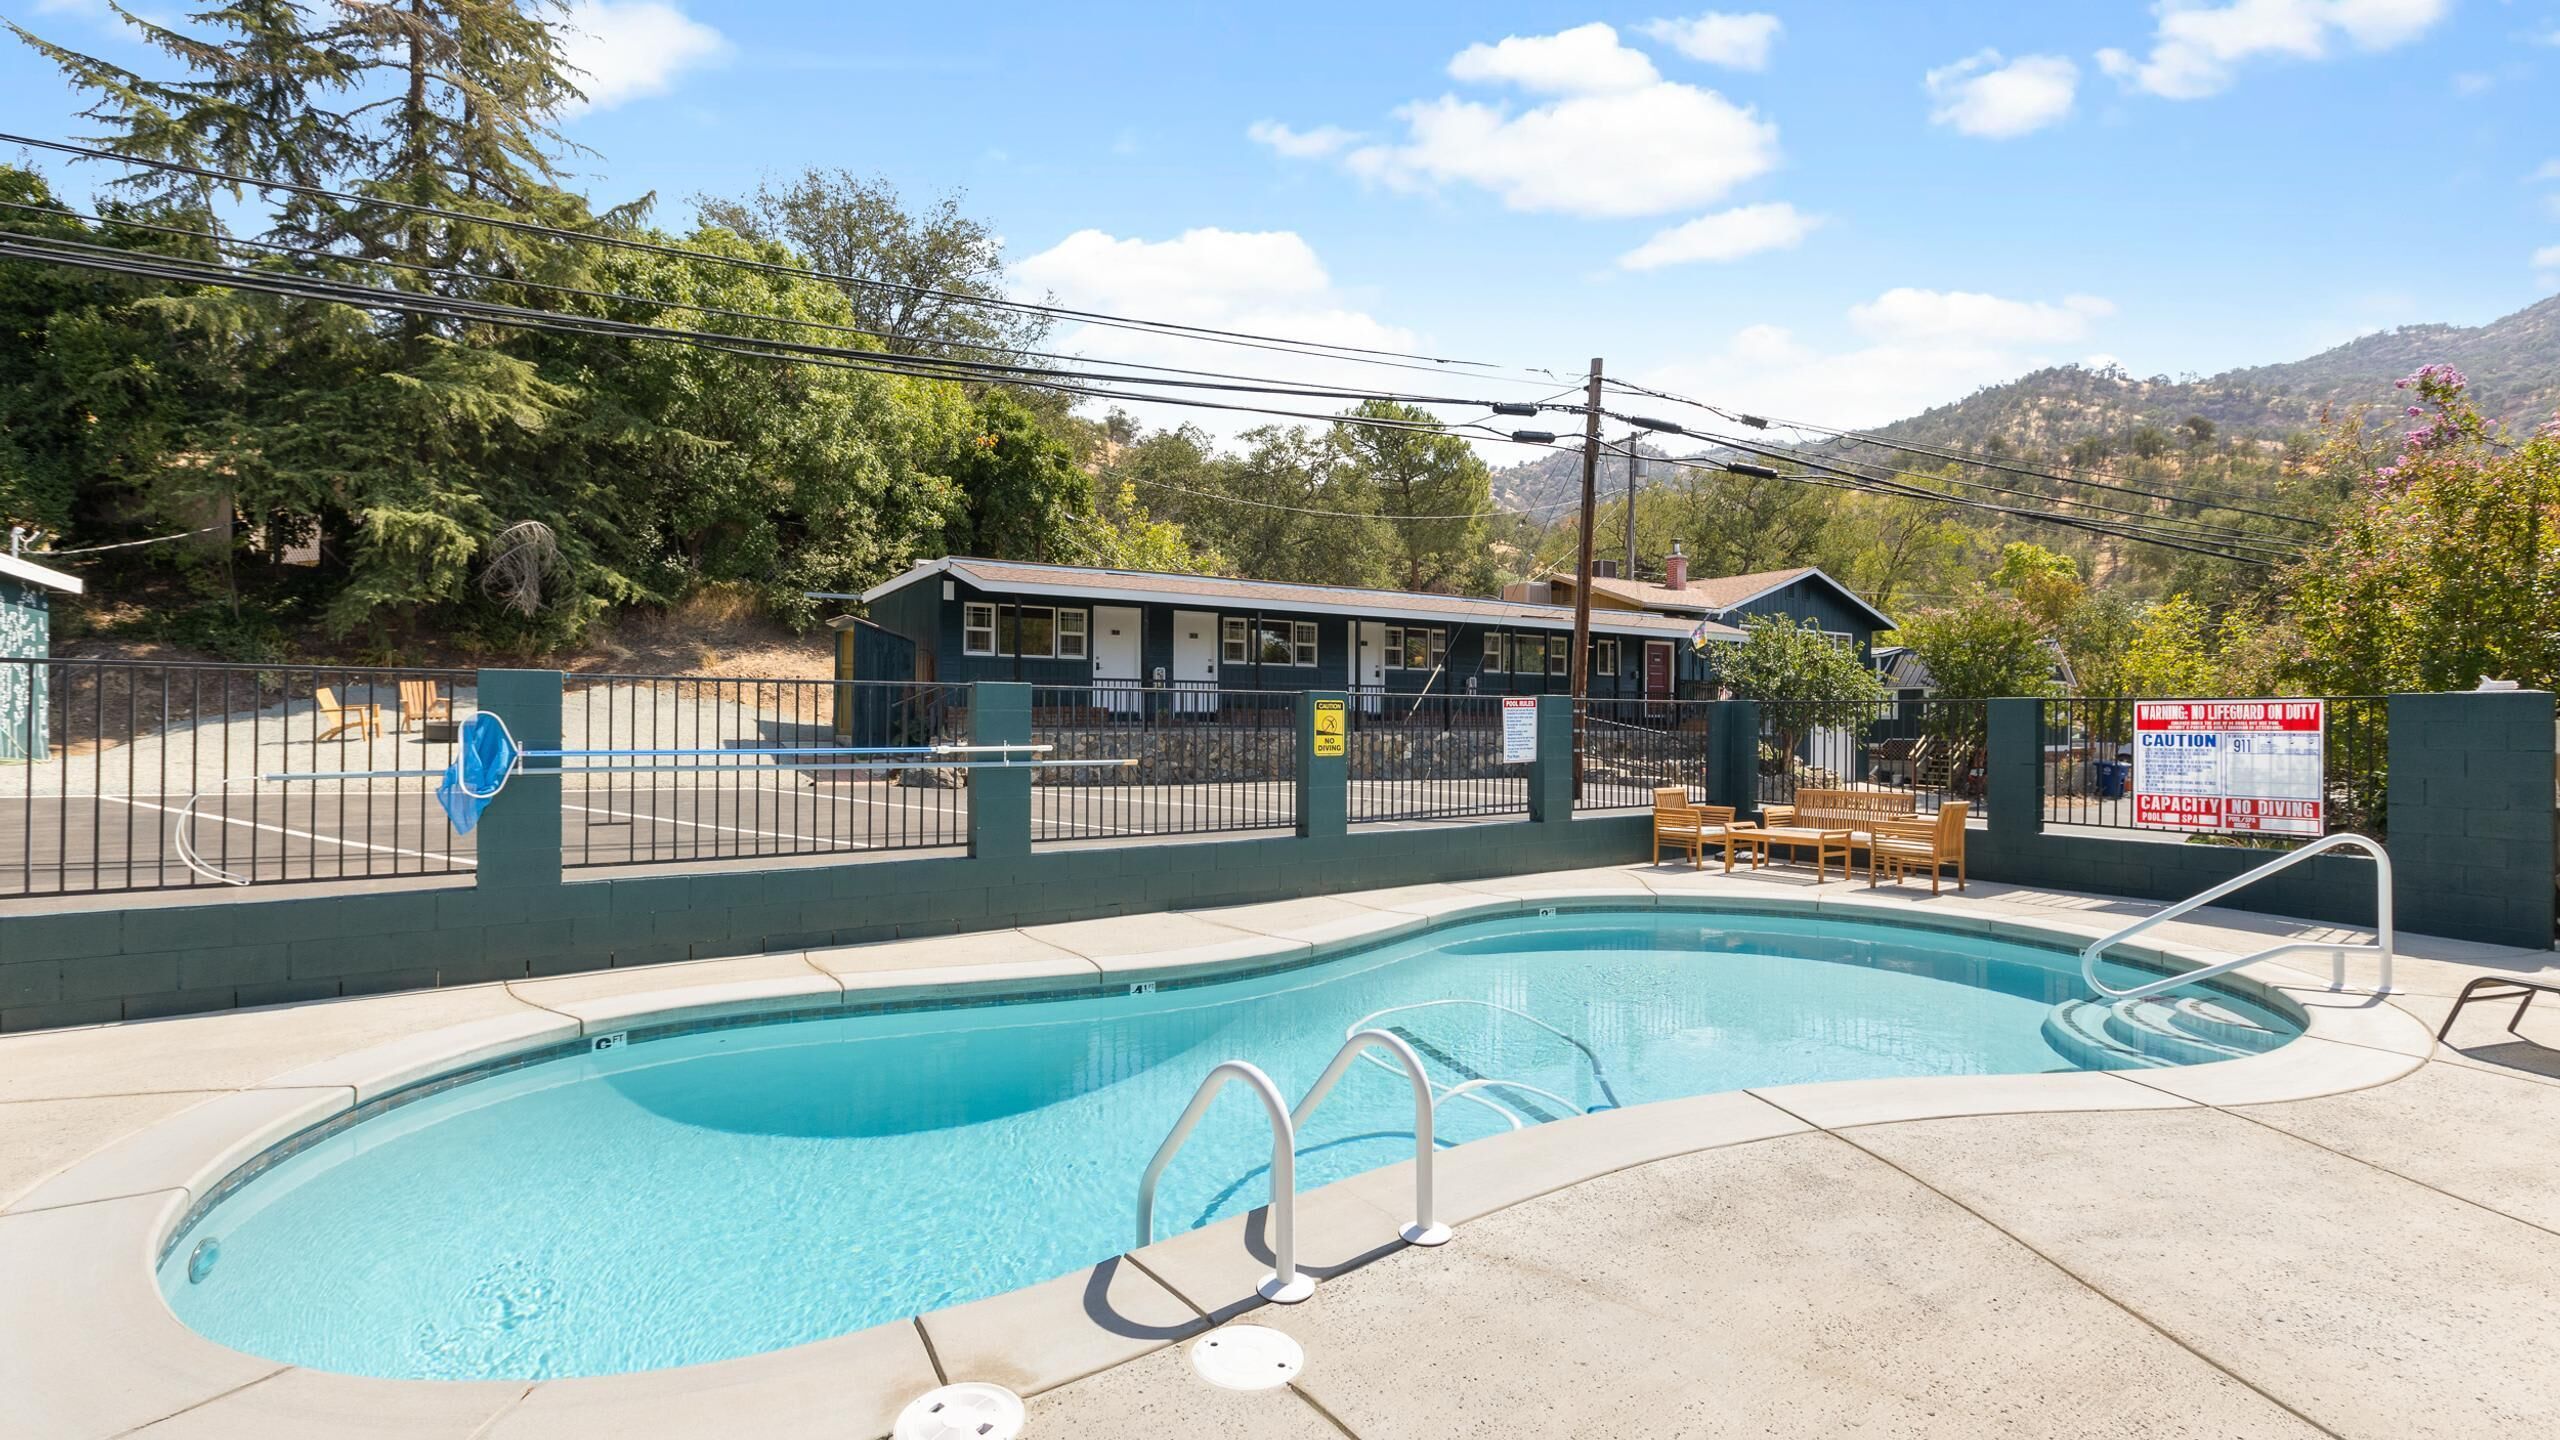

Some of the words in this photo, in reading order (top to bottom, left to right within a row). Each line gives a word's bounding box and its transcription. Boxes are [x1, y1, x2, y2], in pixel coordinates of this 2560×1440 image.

[2140, 705, 2188, 720] WARNING:
[2191, 704, 2205, 720] NO
[2207, 704, 2265, 720] LIFEGUARD
[2268, 703, 2283, 720] ON
[2285, 703, 2317, 720] DUTY
[2142, 734, 2217, 748] CAUTION
[2233, 738, 2251, 753] 911
[2140, 795, 2220, 814] CAPACITY
[2231, 799, 2252, 815] NO
[2257, 800, 2314, 818] DIVING
